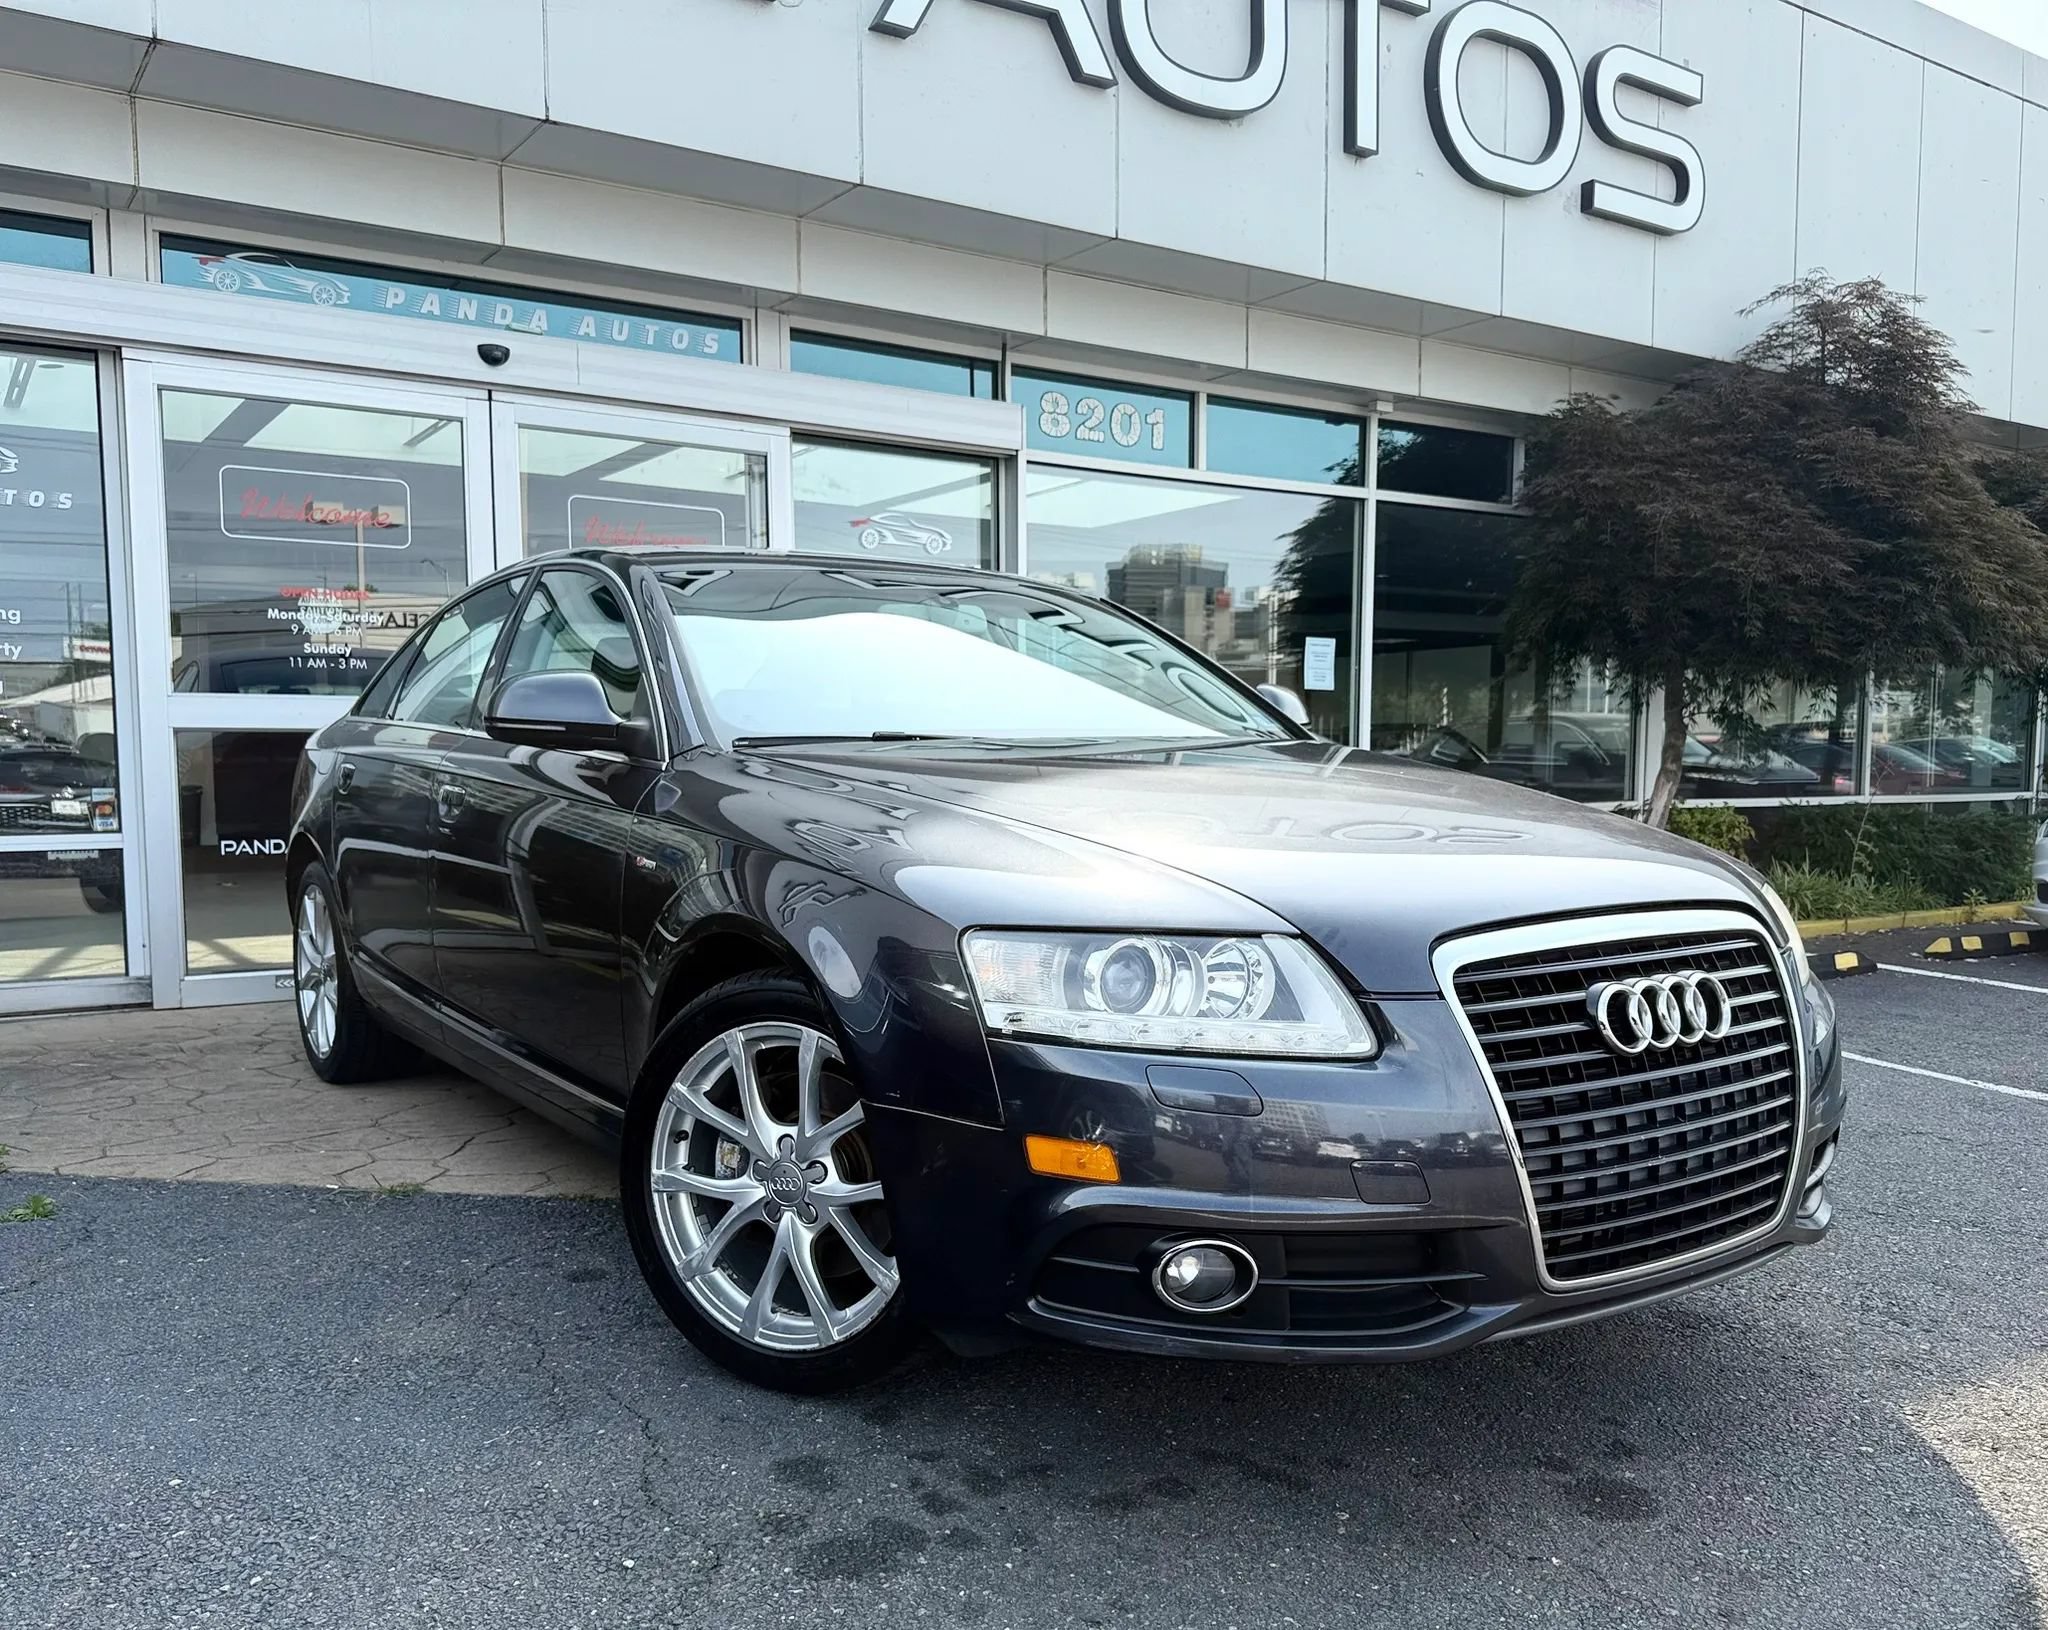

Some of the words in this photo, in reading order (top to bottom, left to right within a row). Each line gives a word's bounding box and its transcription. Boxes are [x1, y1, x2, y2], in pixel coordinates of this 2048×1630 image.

[384, 286, 549, 331] PANDA
[577, 315, 720, 355] AUTOS
[1039, 391, 1165, 451] 8201
[291, 625, 299, 635] 9
[334, 627, 341, 635] 6
[345, 627, 363, 637] PM
[0, 642, 22, 659] ty
[304, 643, 352, 657] Sunday
[289, 657, 302, 668] 11
[307, 658, 327, 668] AM
[338, 659, 346, 669] 3
[350, 660, 367, 669] PM
[220, 838, 289, 856] PAND
